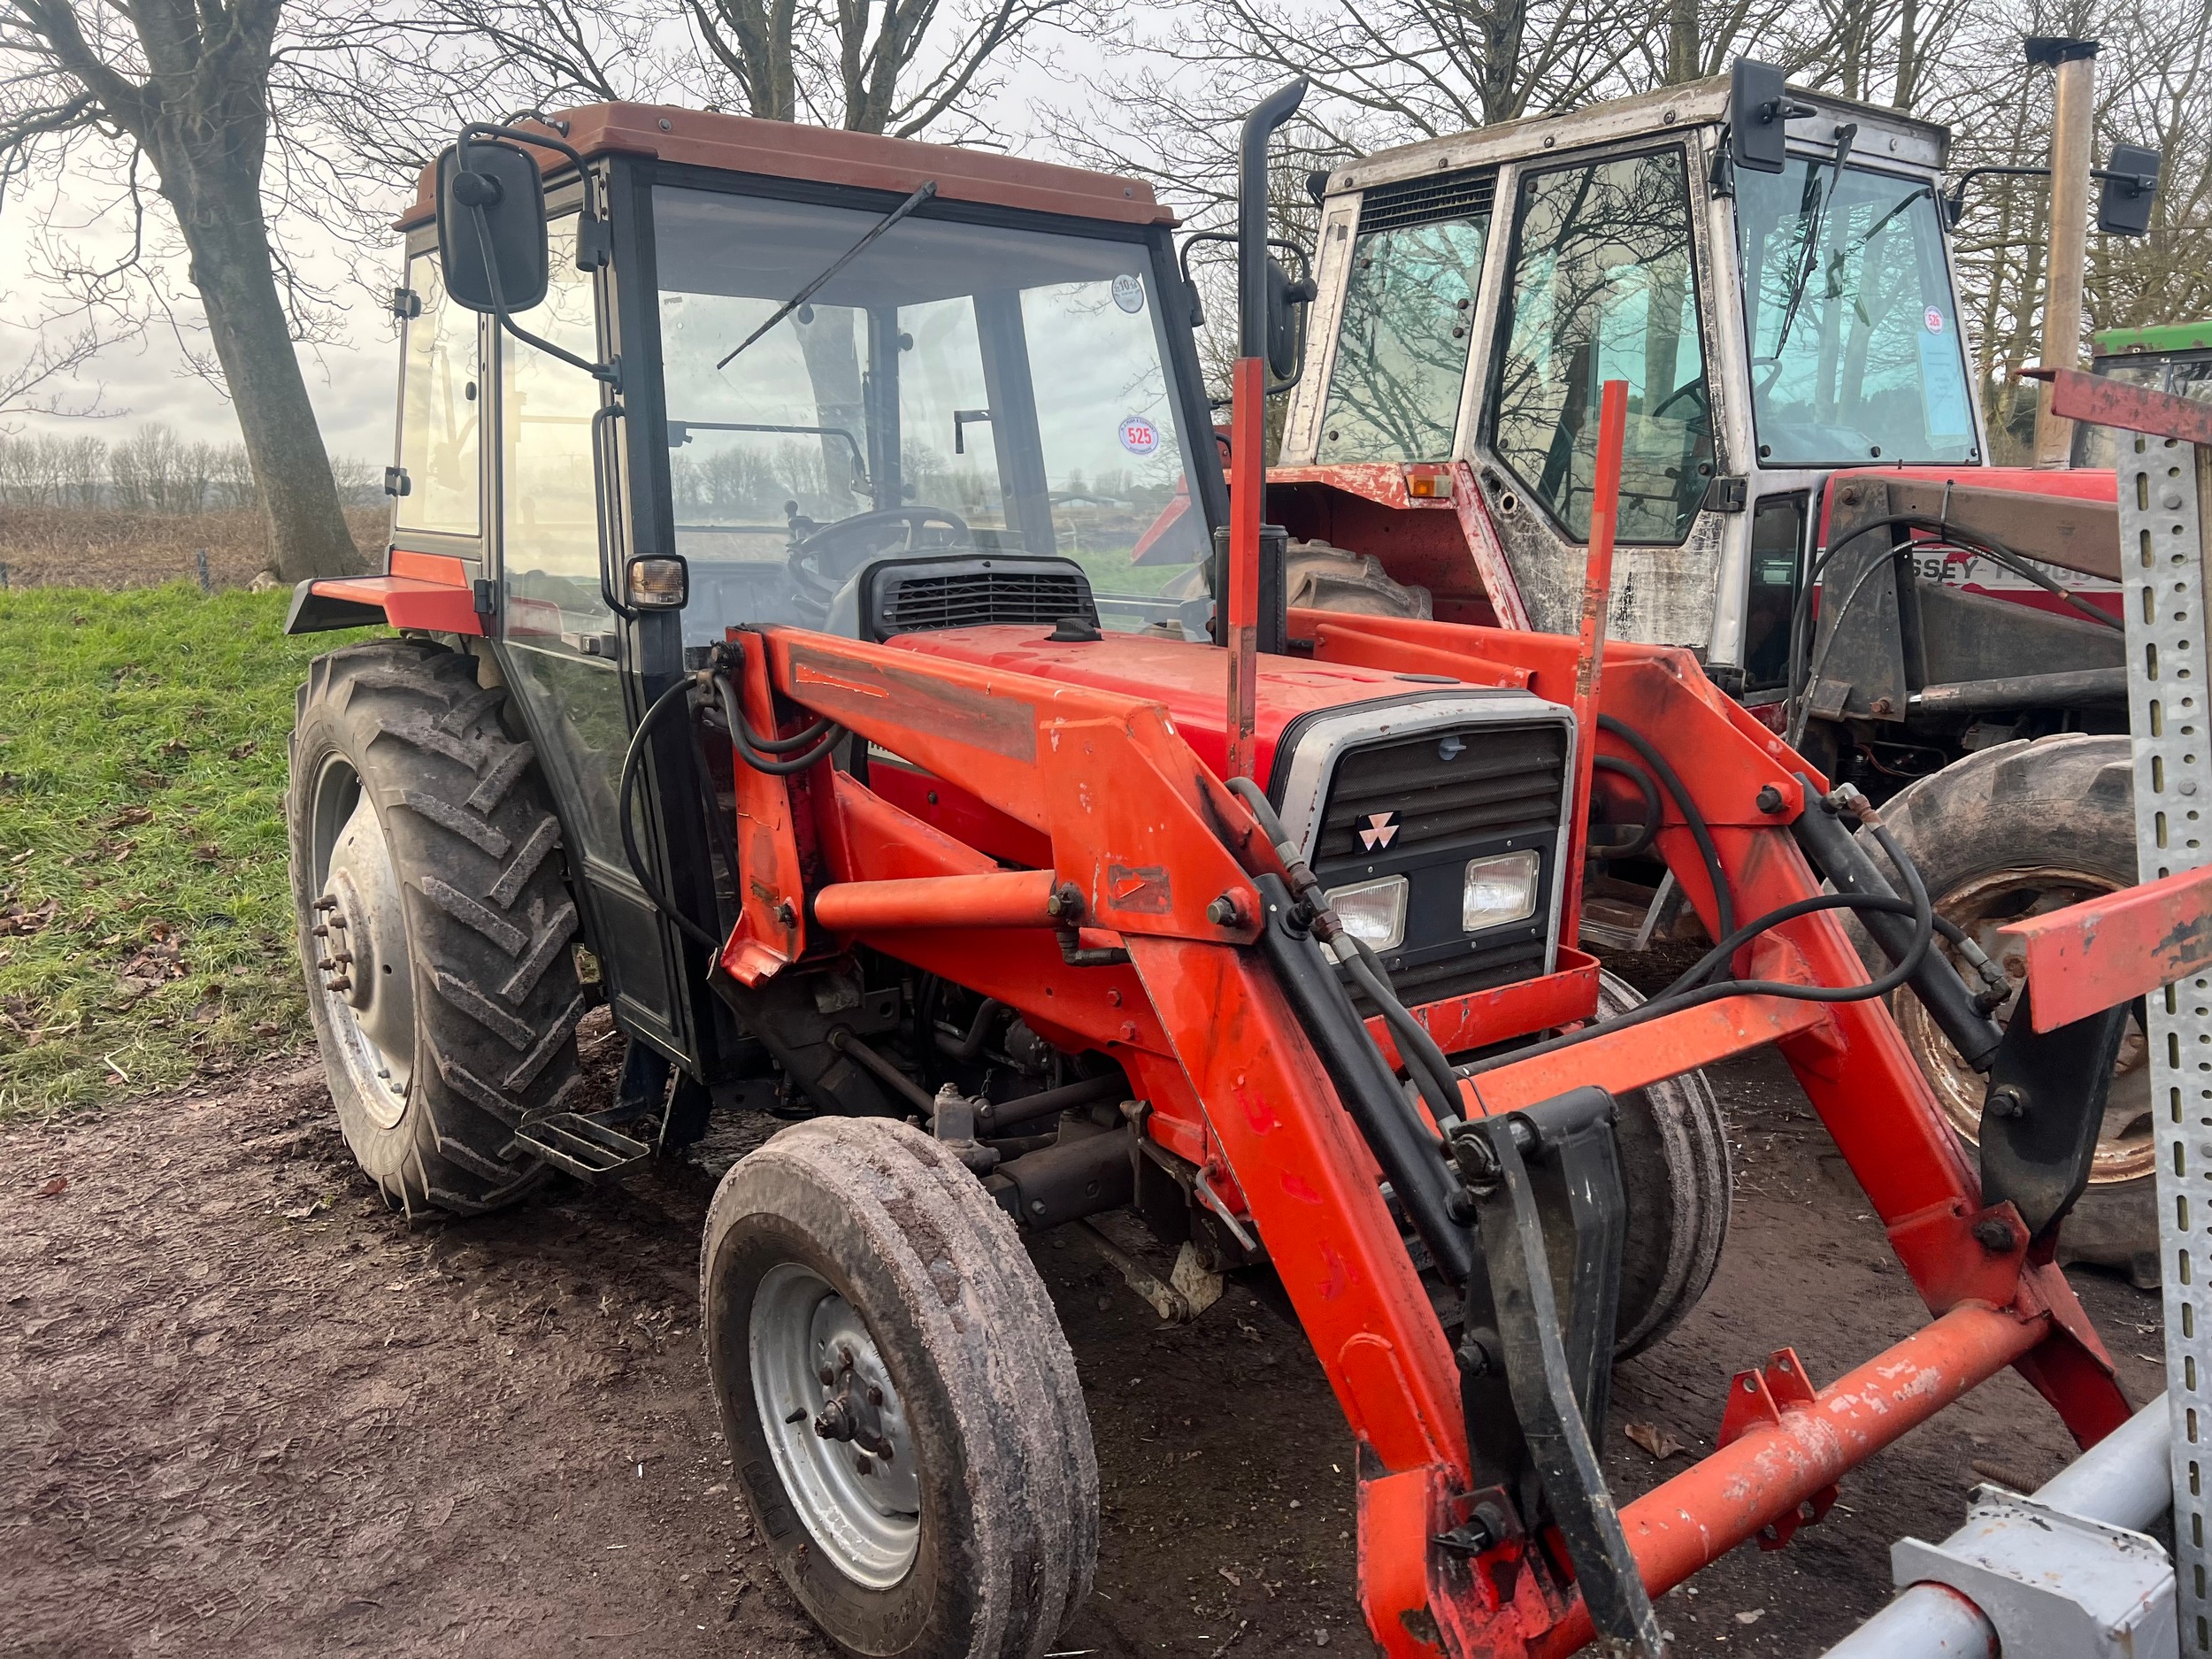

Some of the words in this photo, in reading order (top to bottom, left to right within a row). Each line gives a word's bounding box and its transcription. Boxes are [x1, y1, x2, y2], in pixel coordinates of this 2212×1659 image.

[1119, 280, 1129, 291] 10
[1928, 314, 1940, 326] 526
[1127, 427, 1152, 444] 525
